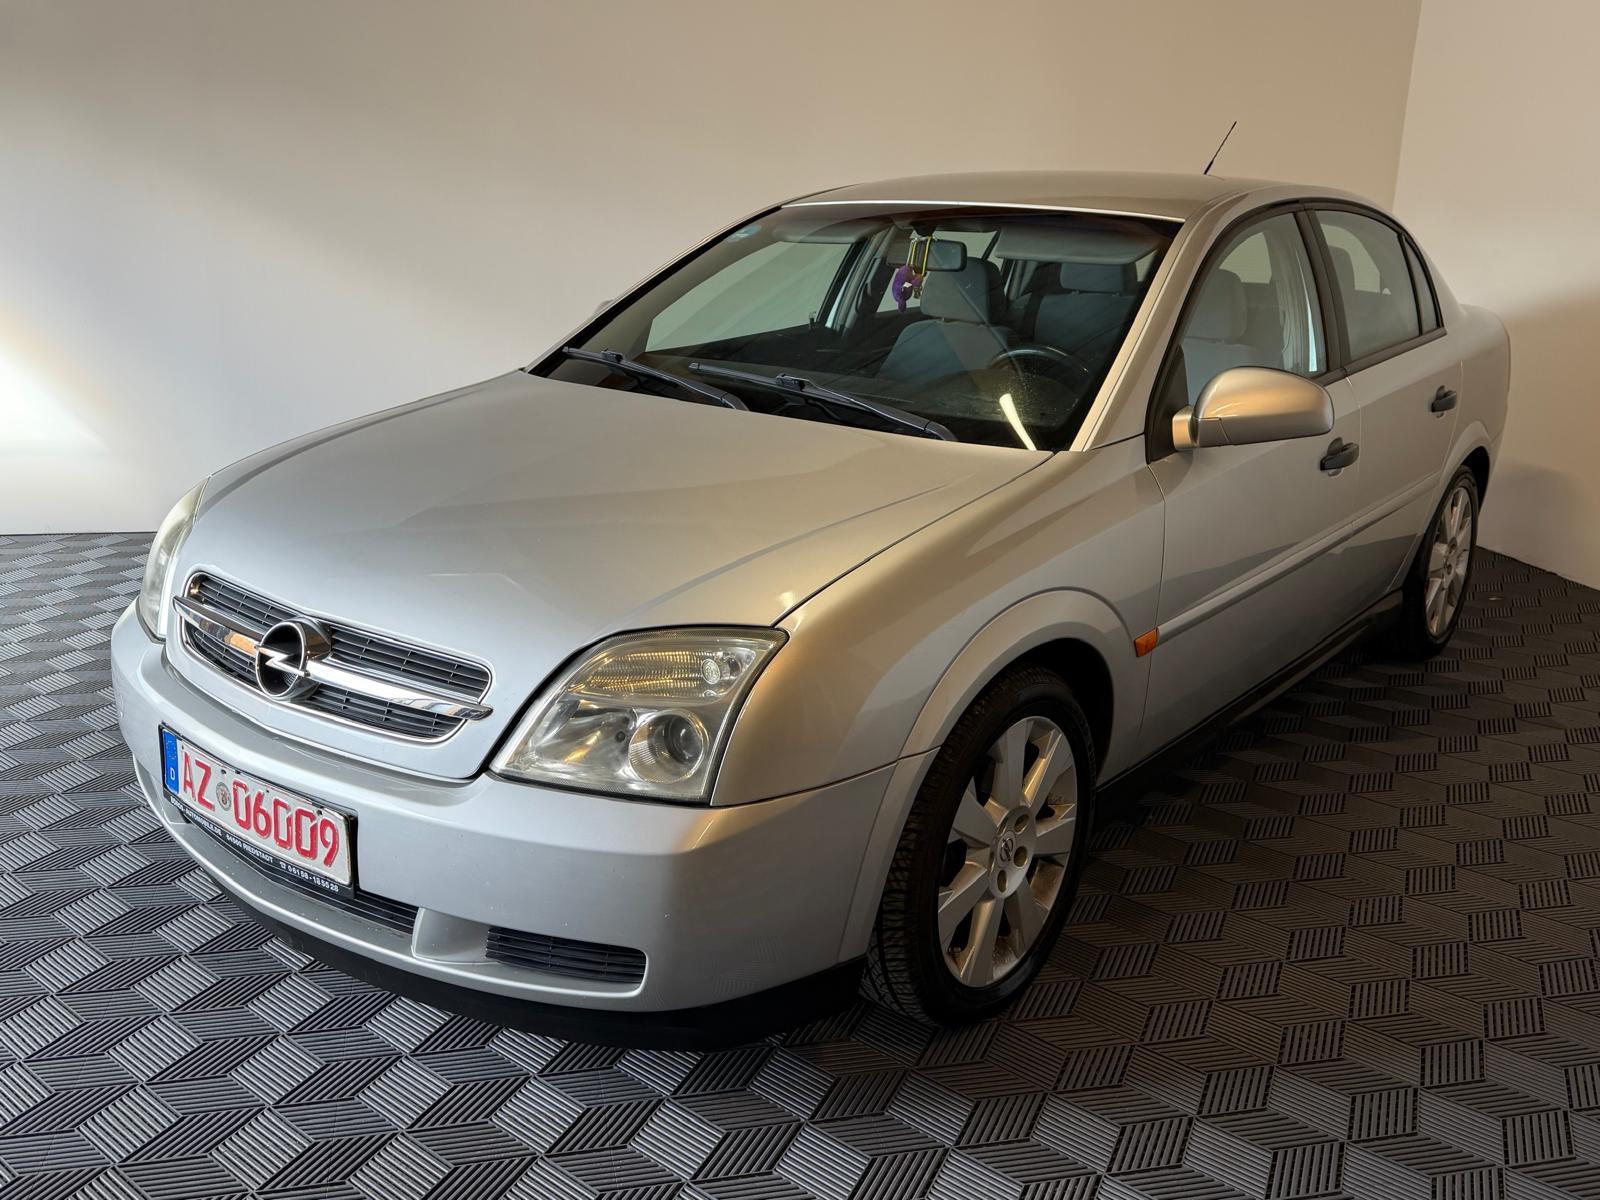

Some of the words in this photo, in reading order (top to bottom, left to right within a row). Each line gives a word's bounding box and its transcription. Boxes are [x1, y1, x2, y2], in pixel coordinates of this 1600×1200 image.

[169, 767, 176, 781] D
[183, 751, 215, 812] AZ
[232, 778, 339, 868] 06009
